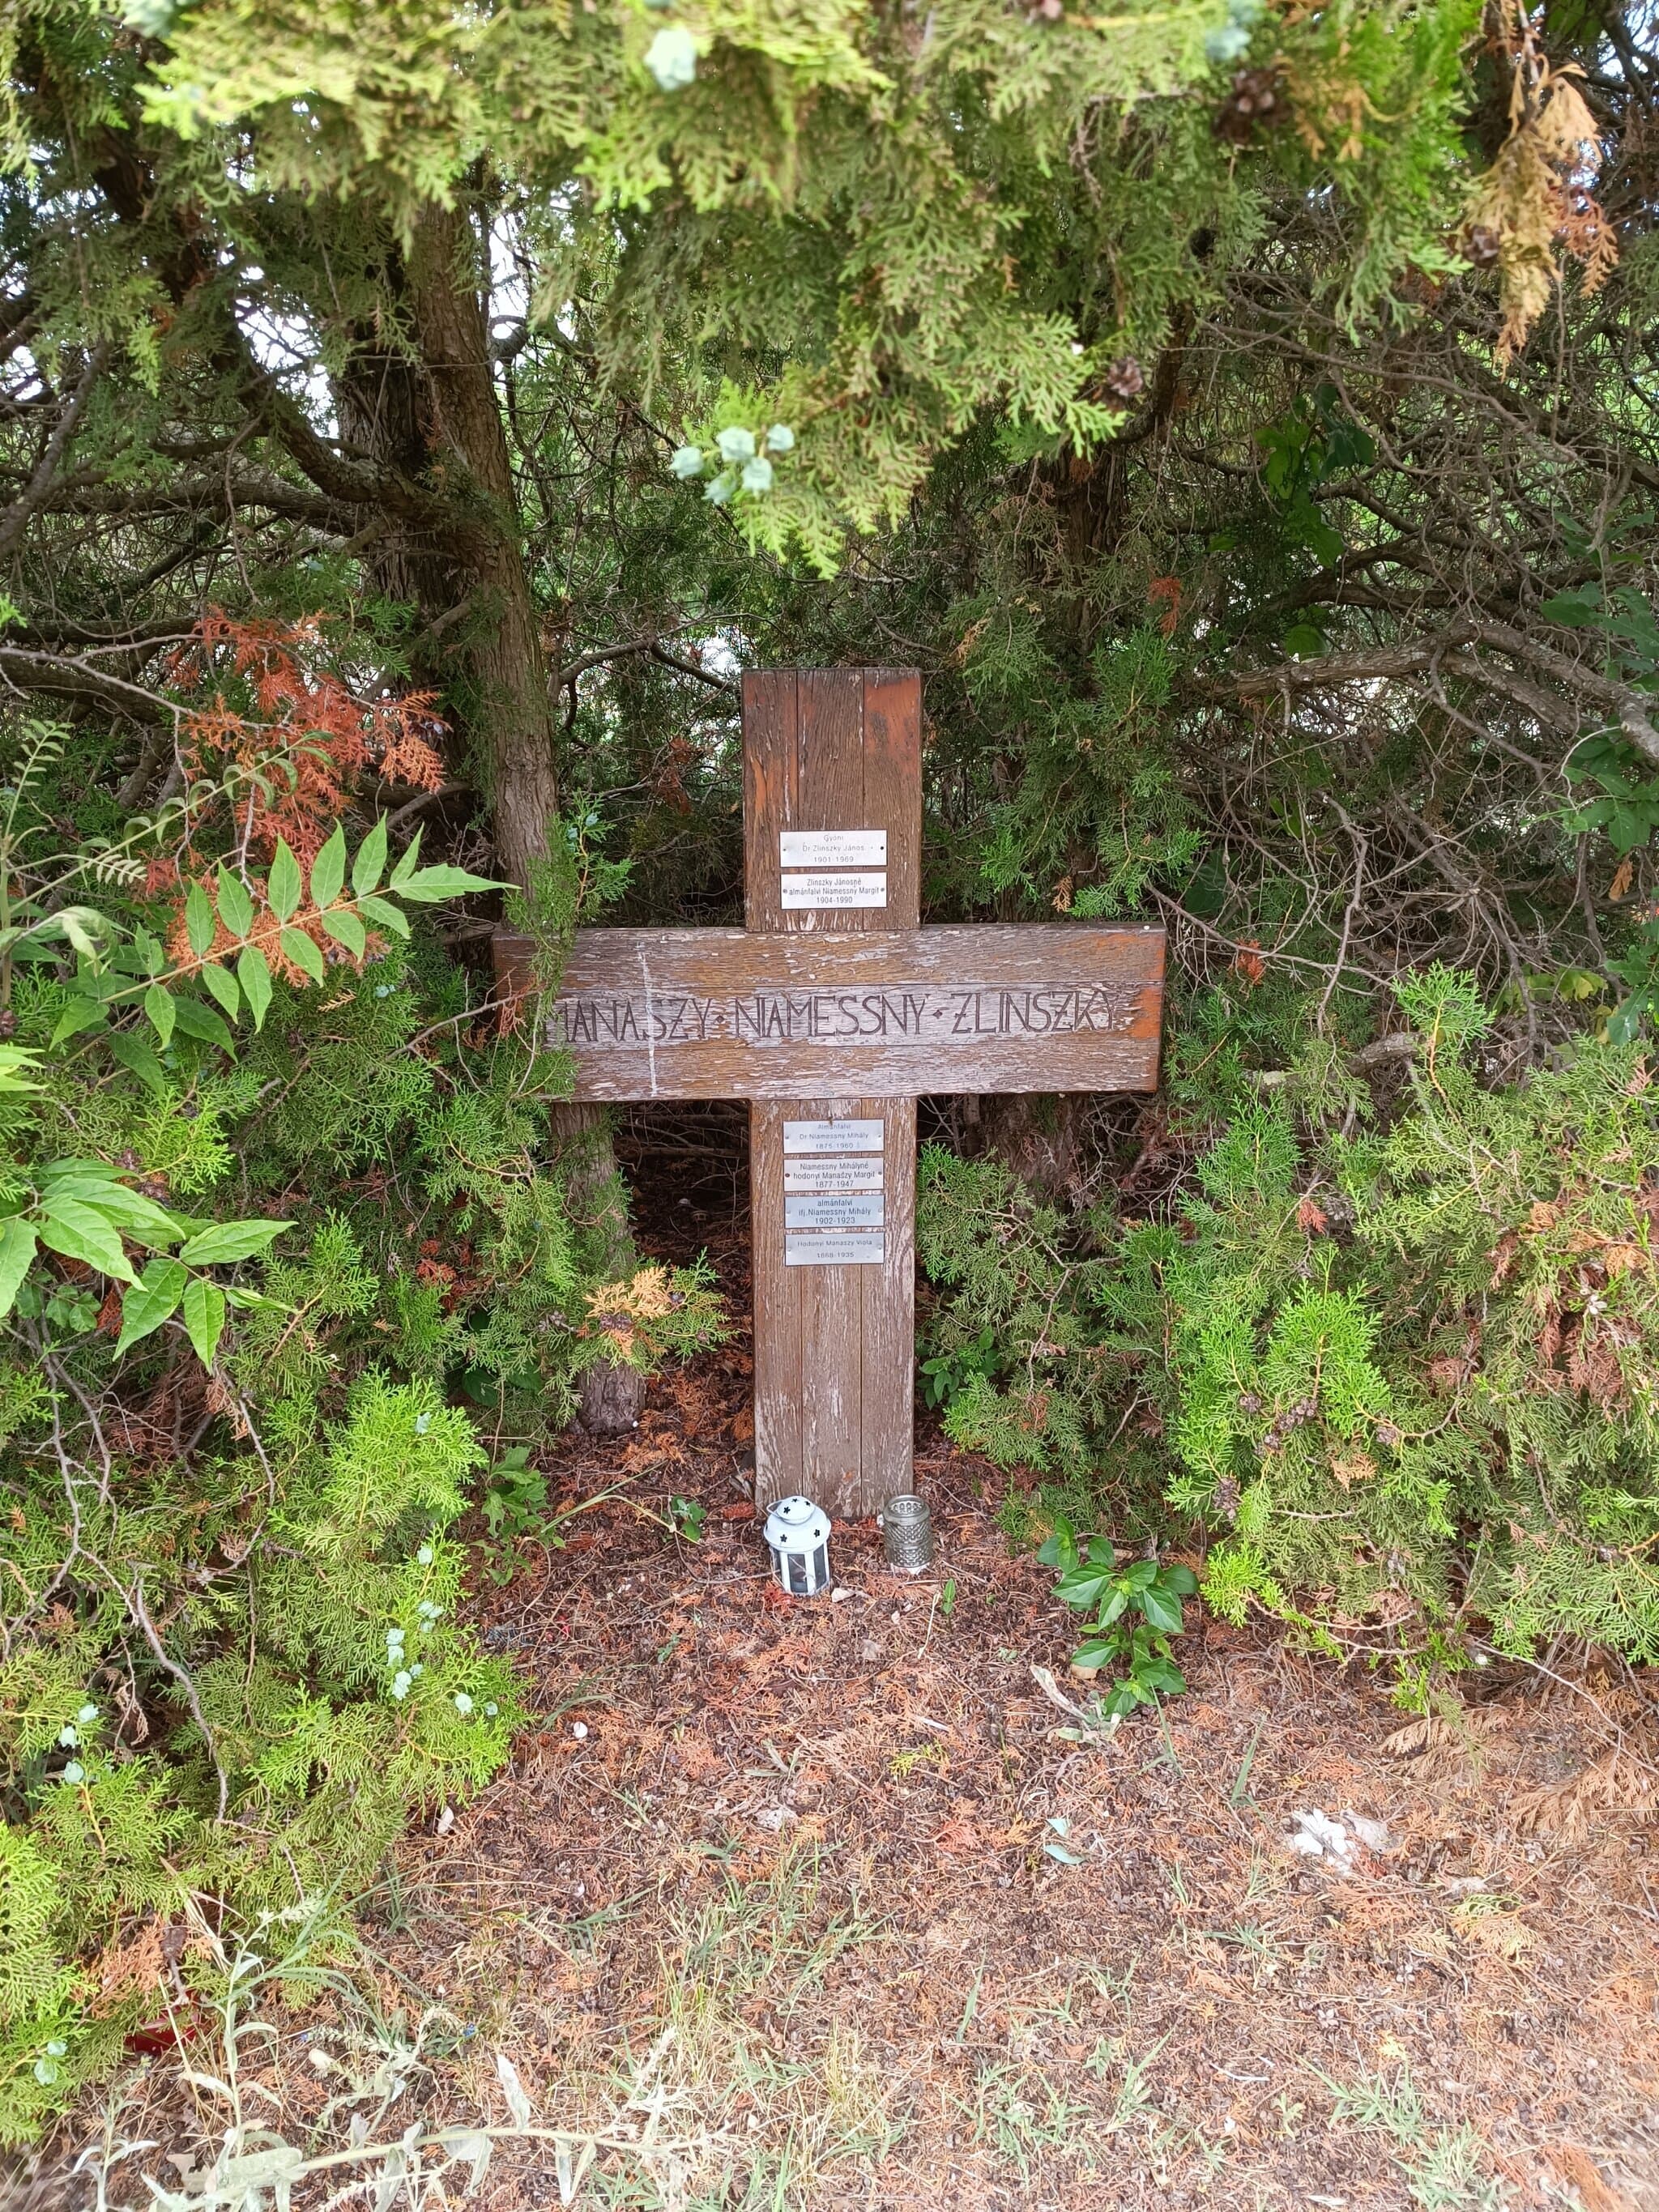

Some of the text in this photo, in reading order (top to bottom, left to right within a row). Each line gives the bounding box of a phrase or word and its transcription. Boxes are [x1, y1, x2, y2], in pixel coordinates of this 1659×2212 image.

[807, 877, 862, 888] Zlinszky Jánosné
[859, 886, 879, 895] Margit
[732, 994, 931, 1038] NIAMESSNY
[800, 1161, 869, 1172] Niamessny Mihályné
[854, 1170, 876, 1178] Margit
[816, 1180, 854, 1188] 1877-1947
[848, 1208, 872, 1216] Mihály
[815, 1217, 855, 1225] 1902-1923
